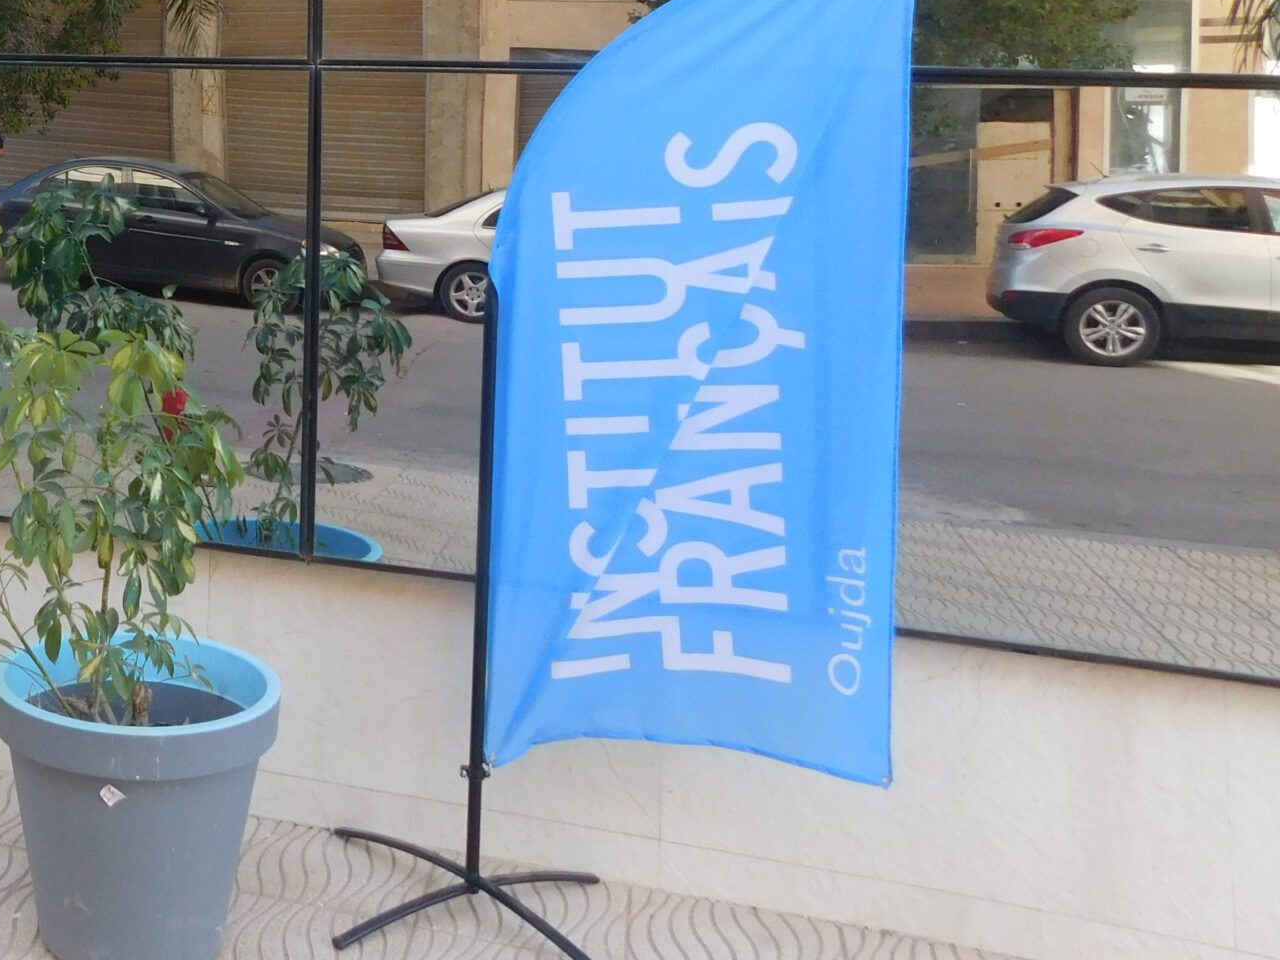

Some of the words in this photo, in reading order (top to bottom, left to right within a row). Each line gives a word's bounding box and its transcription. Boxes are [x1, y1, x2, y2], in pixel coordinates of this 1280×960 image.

[551, 192, 688, 680] INSTITUT
[656, 121, 806, 684] FRANÇAIS
[827, 546, 872, 696] Oujda
